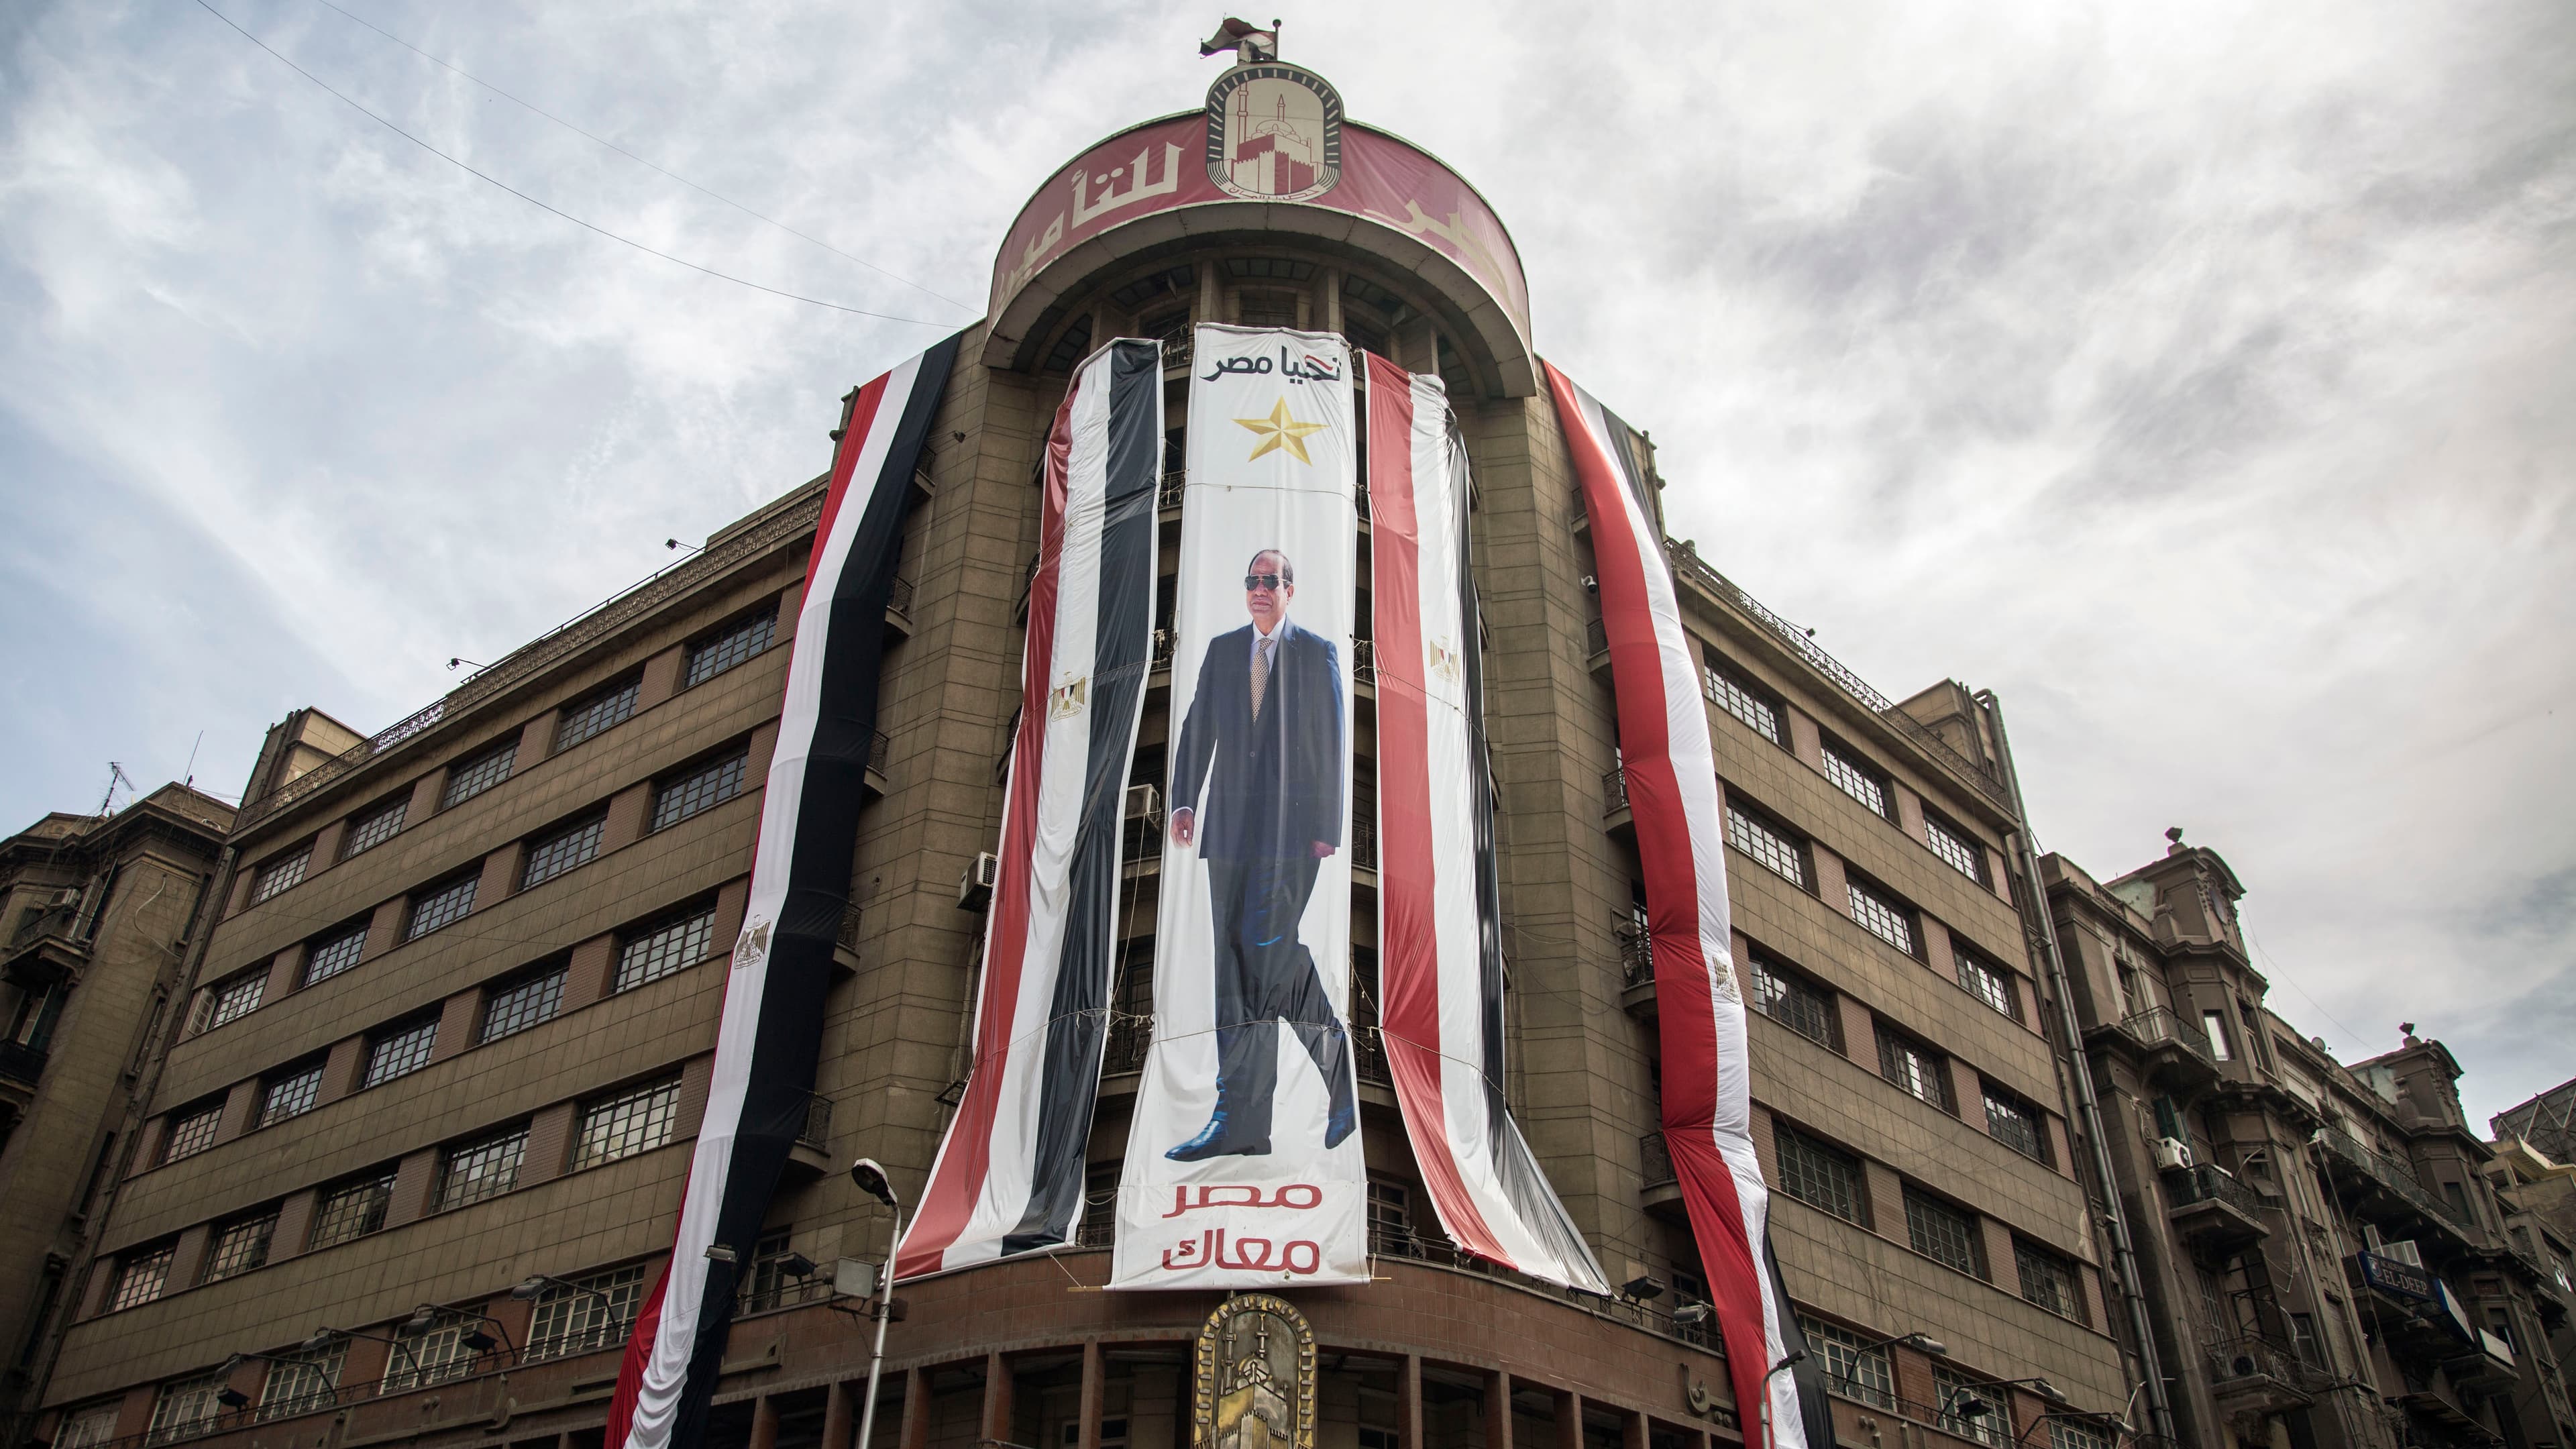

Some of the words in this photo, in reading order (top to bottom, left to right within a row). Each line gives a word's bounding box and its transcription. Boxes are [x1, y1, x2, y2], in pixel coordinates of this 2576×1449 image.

[1199, 357, 1273, 382] مصر
[1162, 1184, 1322, 1218] مصر
[1162, 1228, 1320, 1275] معاك
